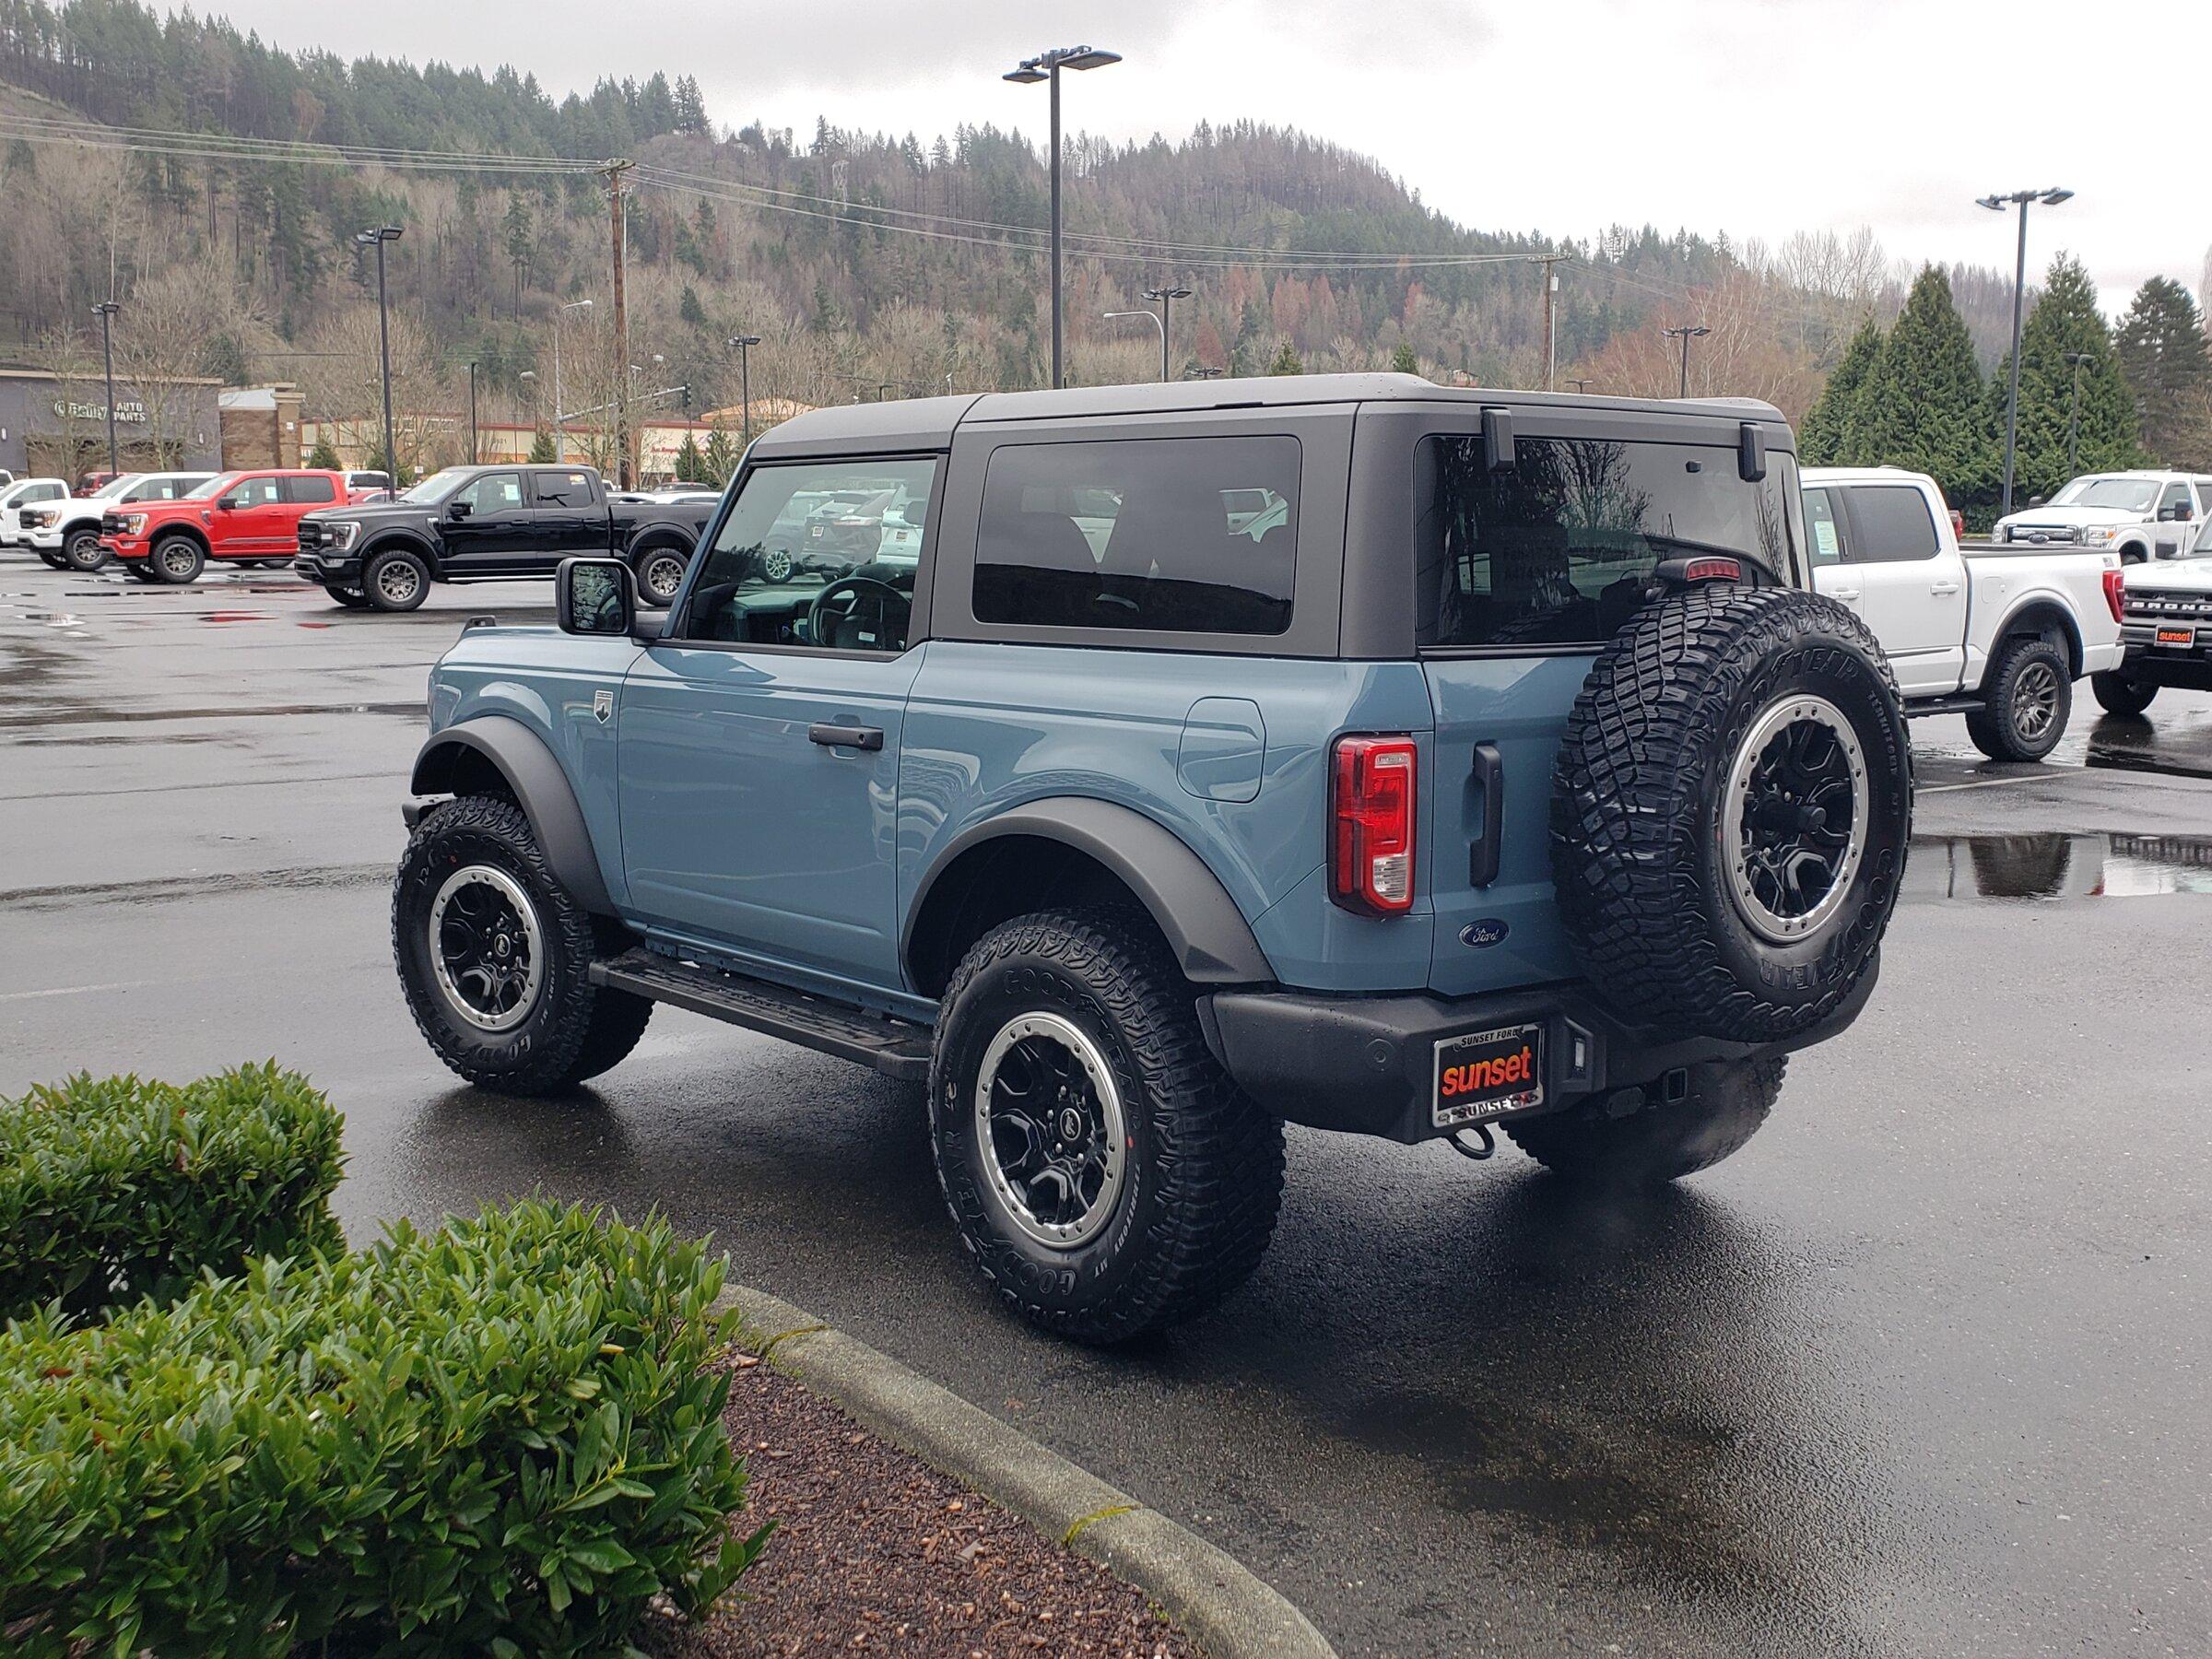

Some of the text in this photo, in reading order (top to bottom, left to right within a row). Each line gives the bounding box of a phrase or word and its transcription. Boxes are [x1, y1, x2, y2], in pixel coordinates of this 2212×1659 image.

[116, 402, 143, 413] AUTO
[113, 412, 146, 422] PARTS
[2159, 631, 2192, 641] sunset
[1461, 1031, 1494, 1046] SUNSET
[1441, 1045, 1531, 1095] sunset
[1113, 1161, 1141, 1257] TERRITORY
